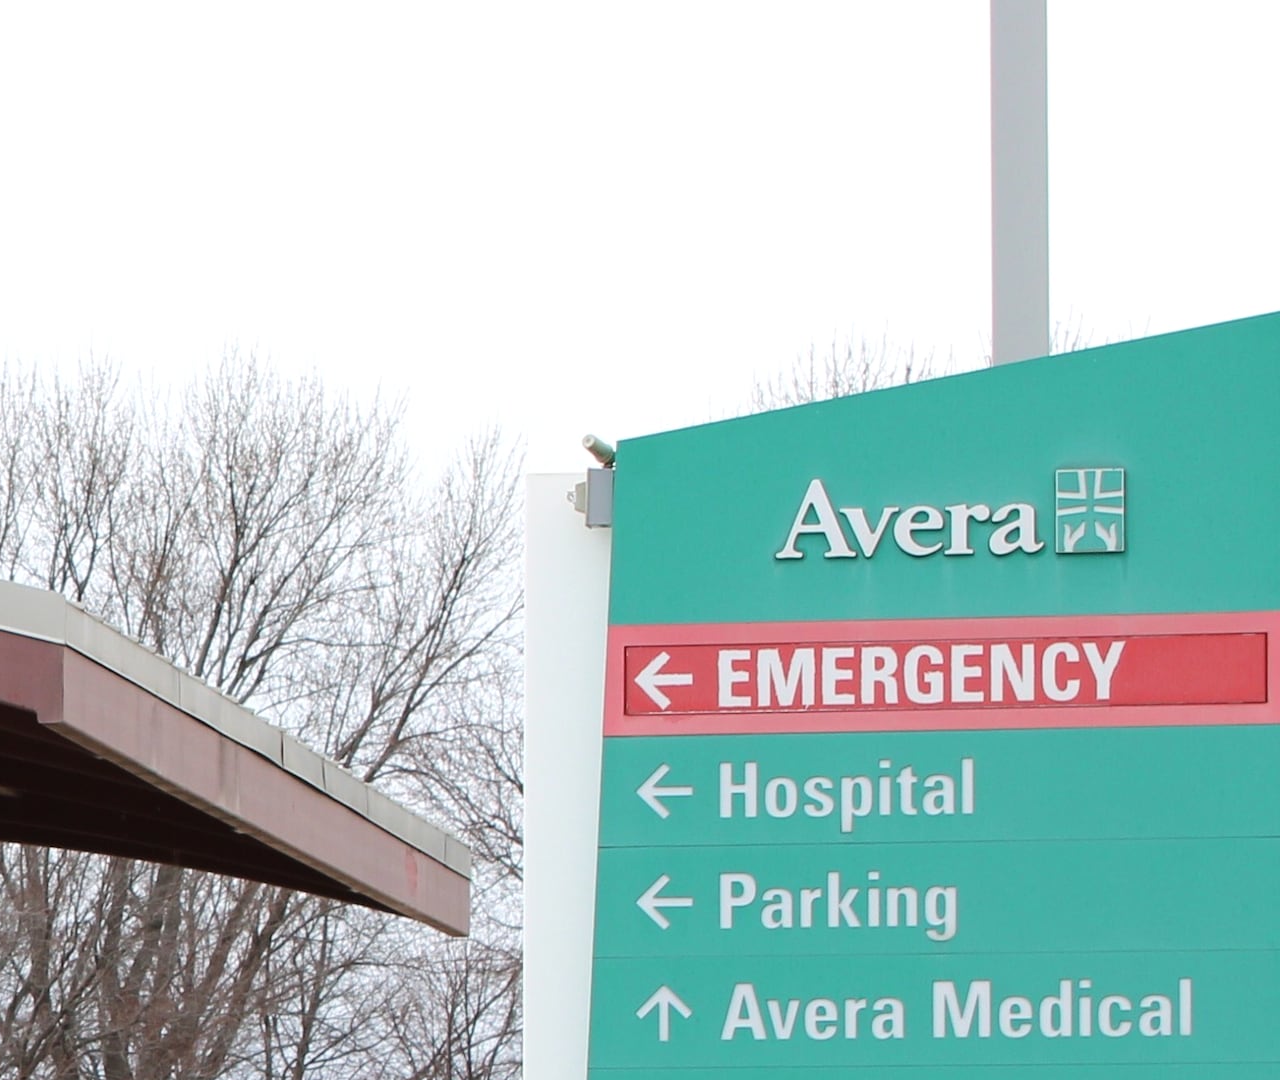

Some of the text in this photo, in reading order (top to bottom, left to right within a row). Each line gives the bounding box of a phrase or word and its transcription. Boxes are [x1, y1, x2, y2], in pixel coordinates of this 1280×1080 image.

[775, 478, 1045, 559] Avera
[718, 640, 1126, 711] EMERGENCY
[719, 758, 975, 833] Hospital
[719, 871, 959, 941] Parking
[721, 978, 1193, 1041] Avera Medical
